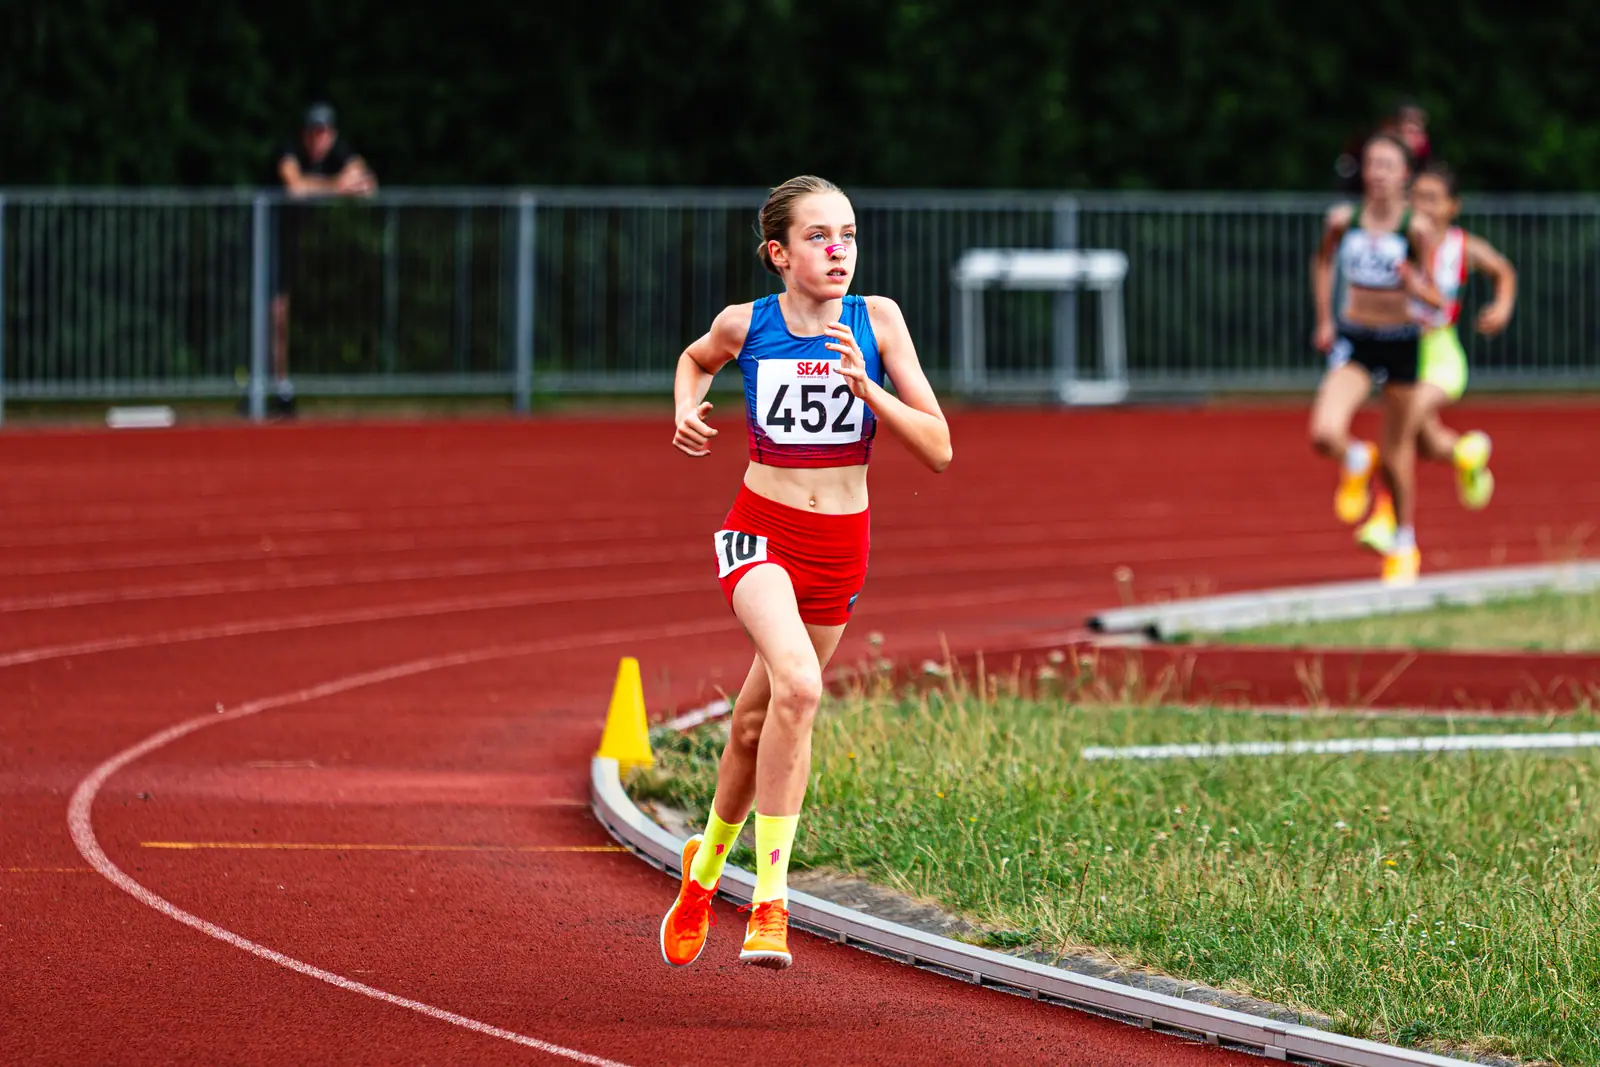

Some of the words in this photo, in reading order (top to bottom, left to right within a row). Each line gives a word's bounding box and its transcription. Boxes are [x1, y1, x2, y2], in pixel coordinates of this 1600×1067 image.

[797, 361, 830, 376] SEAA
[766, 384, 855, 433] 452
[722, 531, 757, 567] 10
